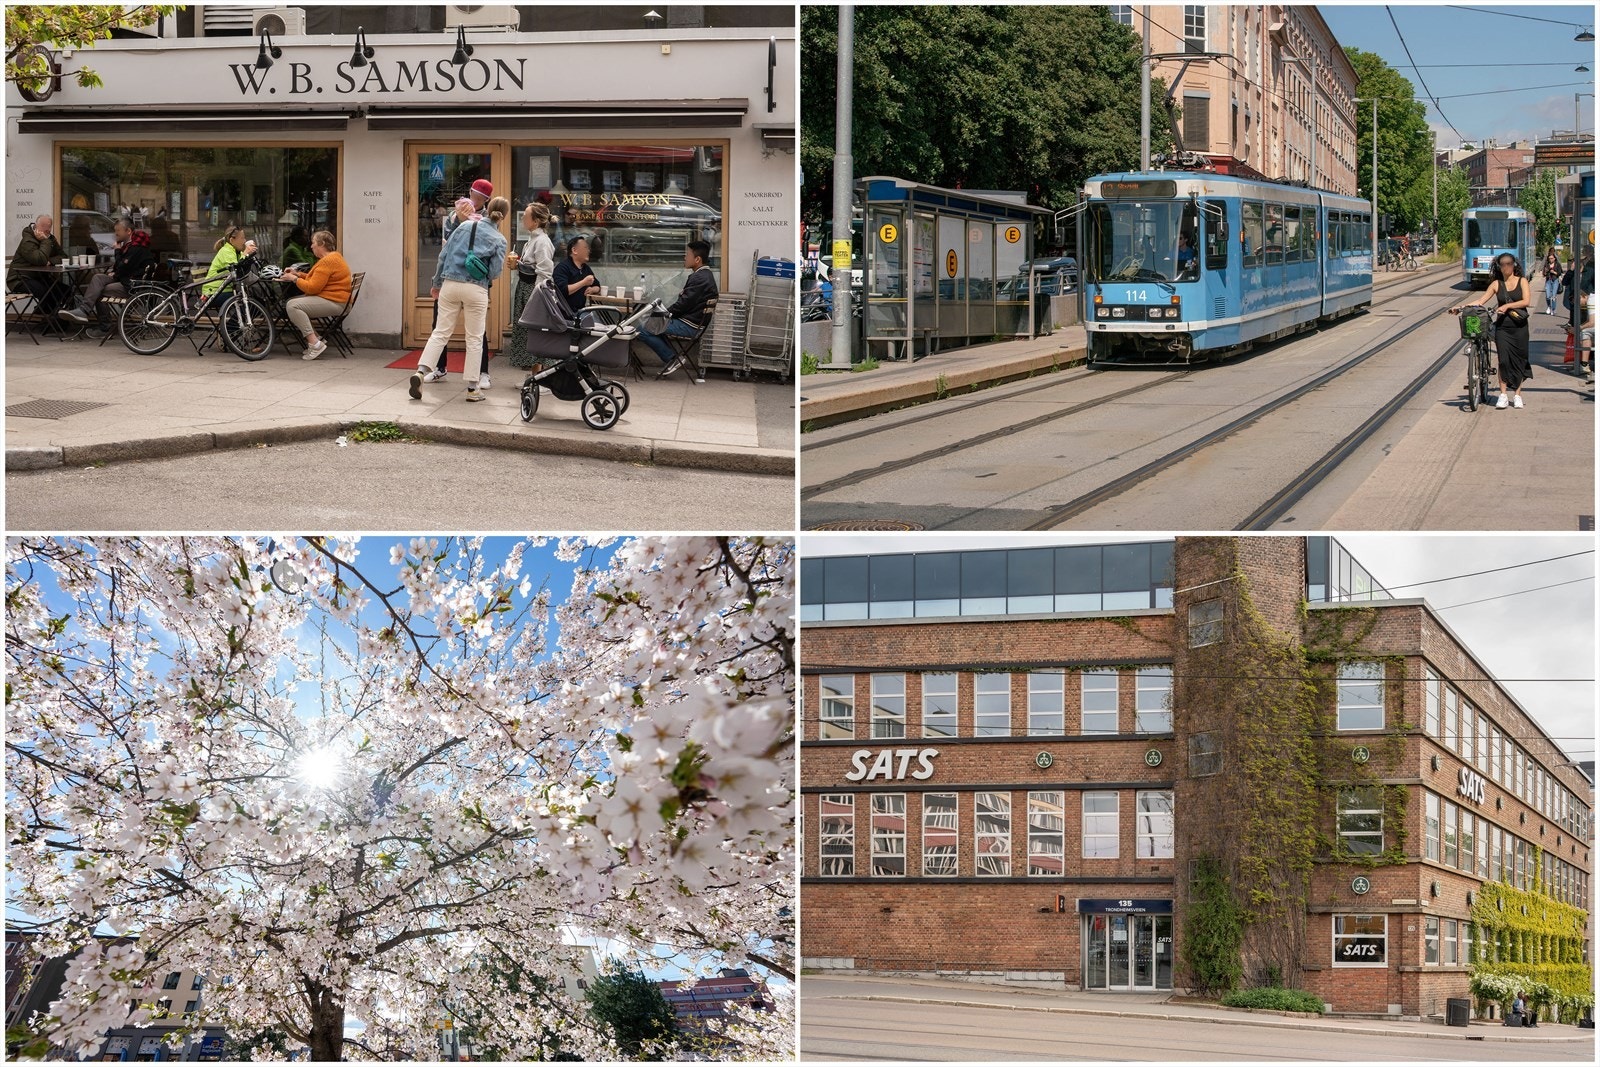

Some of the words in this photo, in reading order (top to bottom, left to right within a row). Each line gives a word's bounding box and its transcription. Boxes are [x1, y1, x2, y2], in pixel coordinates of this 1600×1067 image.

[228, 63, 276, 95] W.
[288, 62, 323, 94] B.
[335, 58, 528, 94] SAMSON
[560, 193, 579, 206] W.
[582, 193, 596, 206] B.
[599, 193, 671, 206] SAMSON
[884, 227, 893, 239] E
[1009, 230, 1016, 240] E
[950, 255, 955, 272] E
[1125, 289, 1147, 302] 114
[845, 748, 940, 781] SATS
[1458, 766, 1486, 805] SATS
[1343, 944, 1378, 956] SATS
